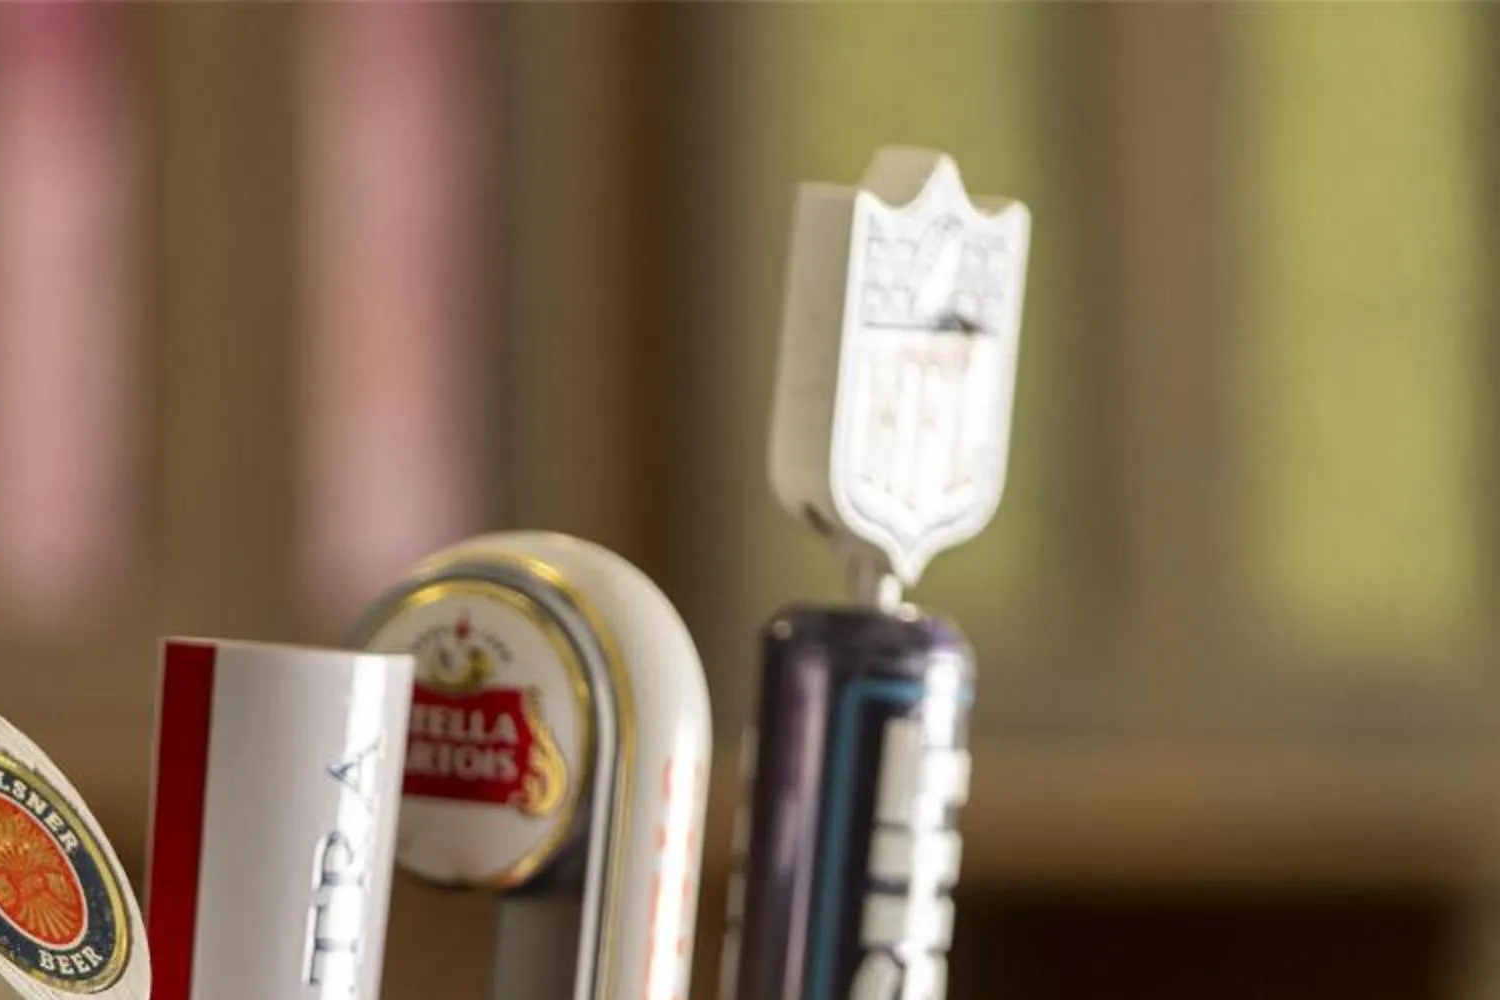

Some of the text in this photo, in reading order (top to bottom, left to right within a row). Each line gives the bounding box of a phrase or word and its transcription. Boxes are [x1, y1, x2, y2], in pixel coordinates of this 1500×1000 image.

[412, 703, 520, 746] TELLA
[407, 739, 520, 783] RTOIS
[37, 945, 105, 975] BEER
